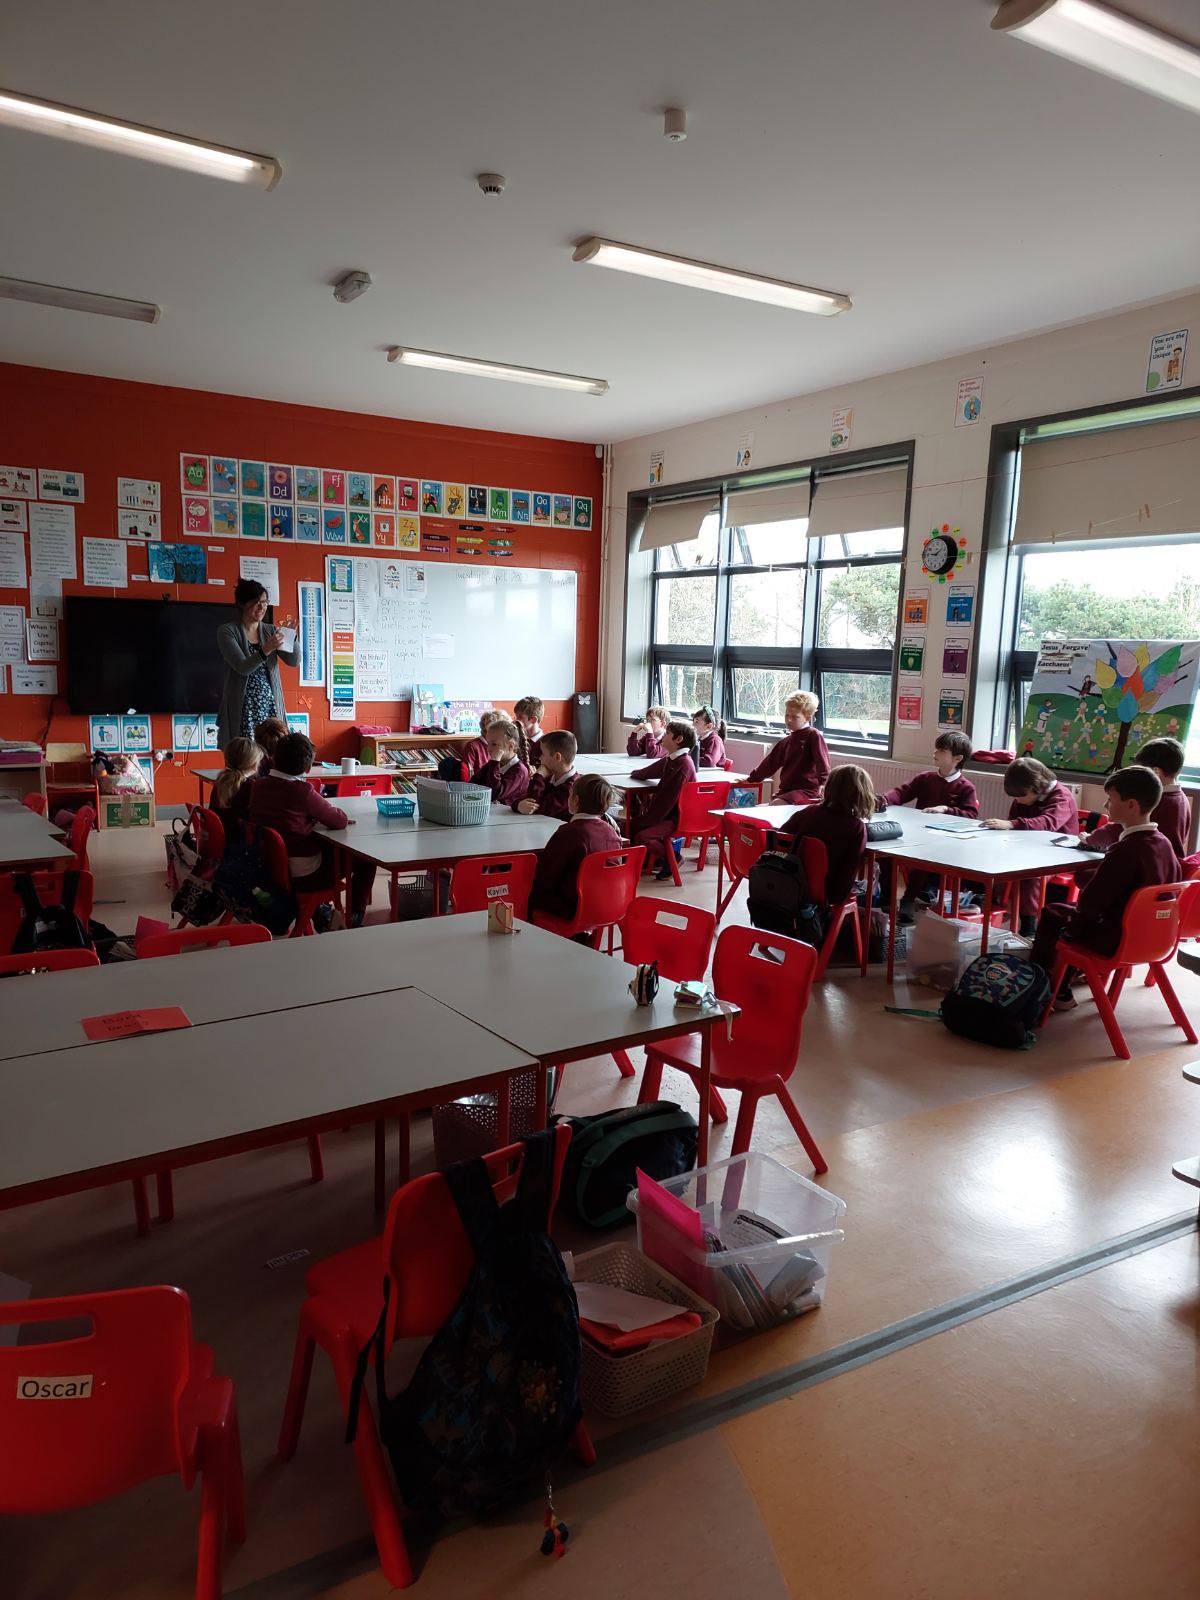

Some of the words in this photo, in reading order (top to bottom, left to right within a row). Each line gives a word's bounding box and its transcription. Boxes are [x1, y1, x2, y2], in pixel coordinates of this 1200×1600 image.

[188, 467, 203, 478] Aa
[331, 475, 341, 488] Ff
[352, 476, 366, 490] Gg
[273, 486, 287, 497] Dd
[378, 495, 392, 506] Hh
[536, 495, 548, 505] Oo
[577, 500, 588, 512] Qq
[273, 507, 288, 517] Uu
[491, 508, 507, 518] Mm
[517, 511, 529, 521] Nn
[188, 518, 201, 527] Rr
[358, 514, 368, 523] Xx
[403, 519, 414, 529] Zz
[303, 527, 317, 537] Vv
[325, 532, 344, 541] Ww
[375, 532, 387, 544] Yy
[21, 1380, 89, 1398] Oscar
